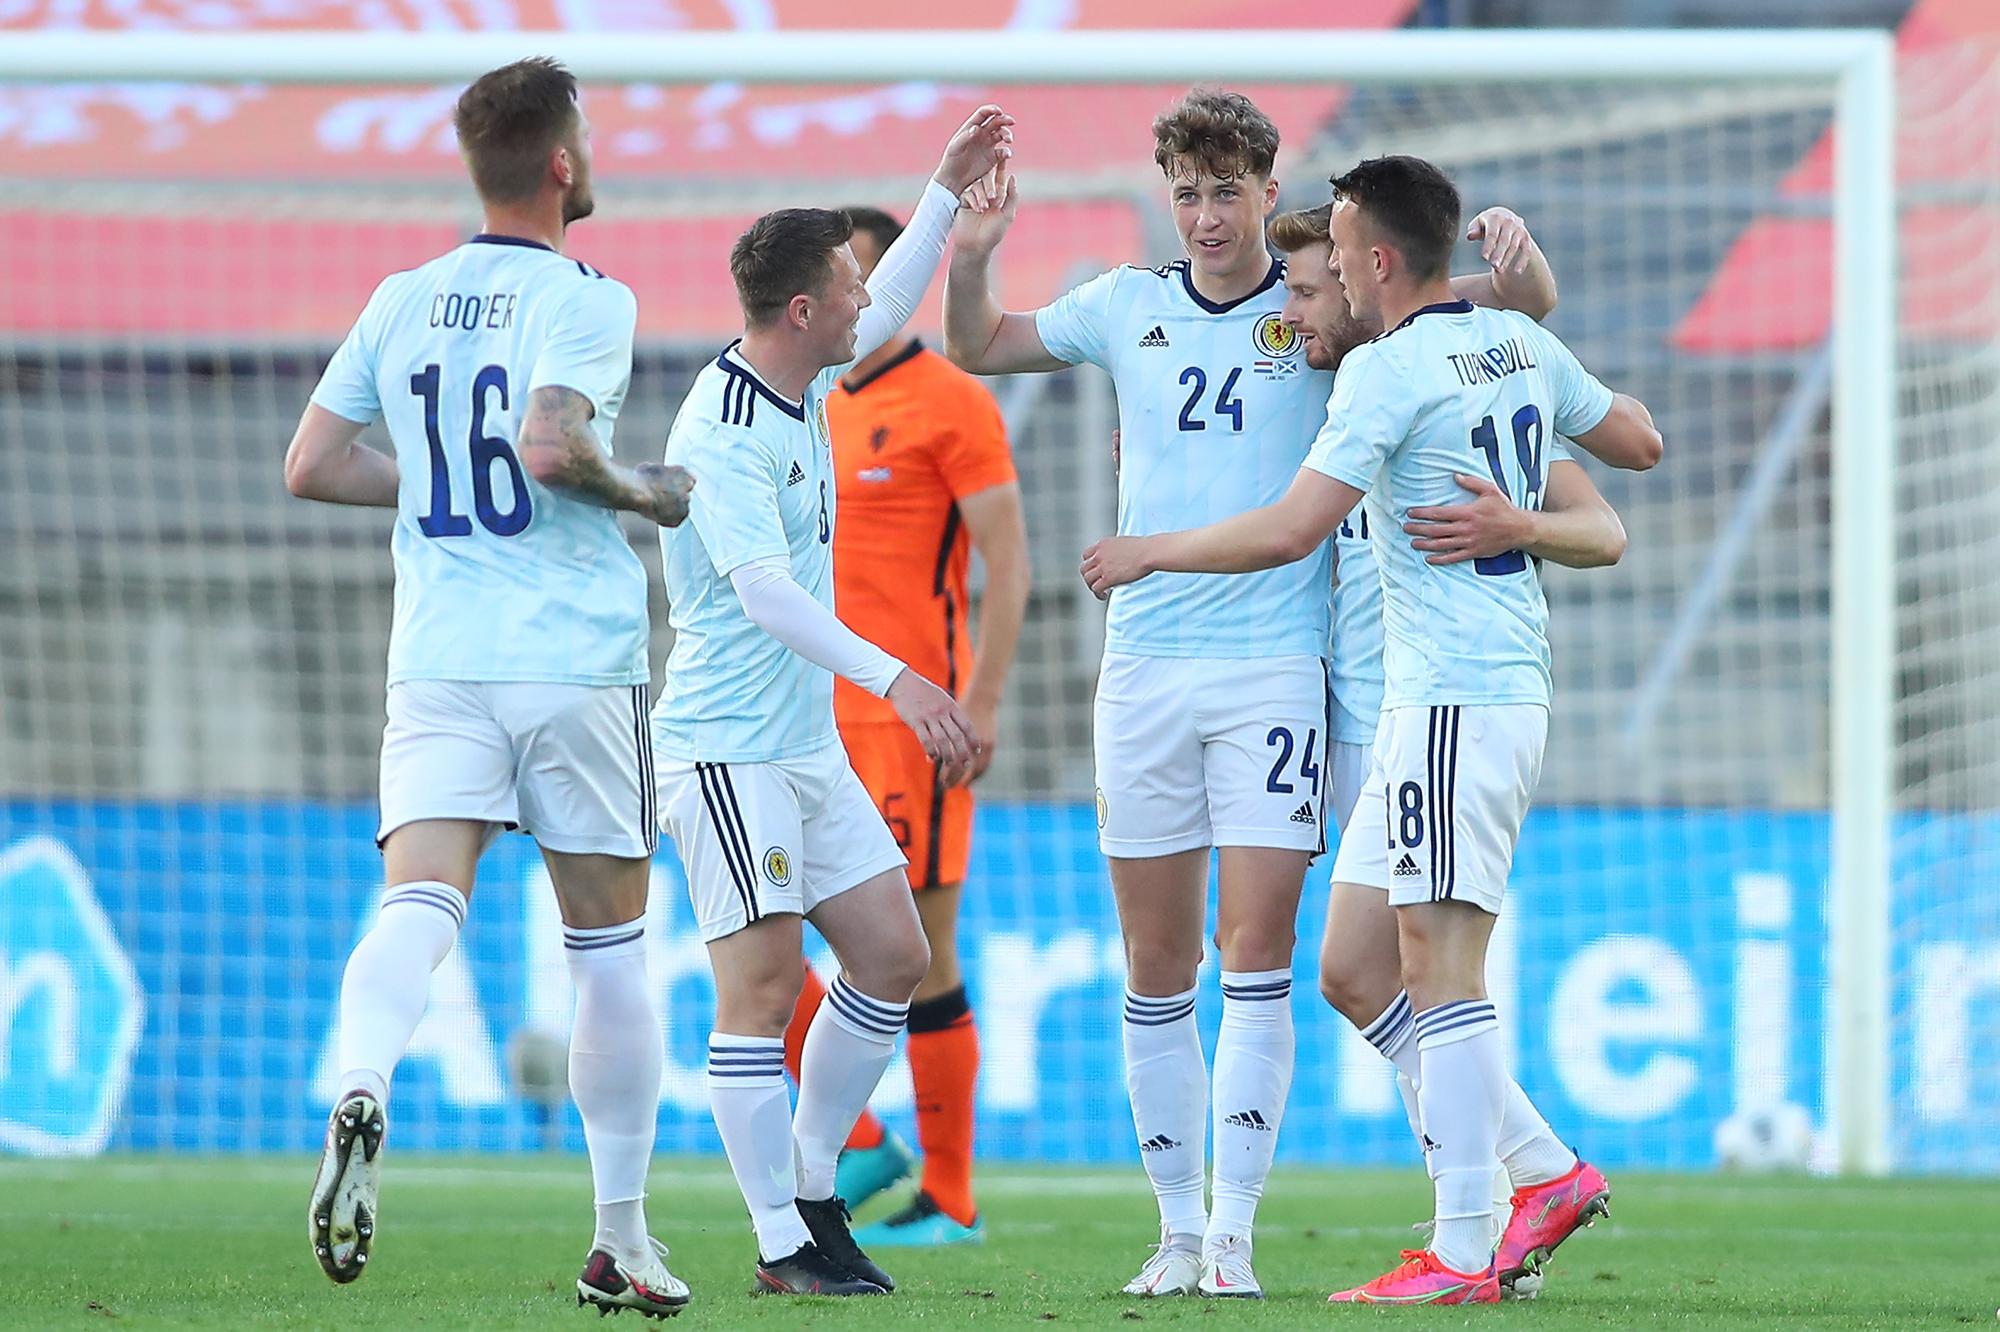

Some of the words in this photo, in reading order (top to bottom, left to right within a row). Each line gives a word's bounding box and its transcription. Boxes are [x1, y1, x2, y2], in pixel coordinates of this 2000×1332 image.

[1138, 339, 1170, 348] adidas
[1447, 335, 1537, 386] TURNBULL
[1178, 366, 1243, 432] 24
[410, 364, 533, 538] 16
[1265, 726, 1320, 797] 24
[1223, 1116, 1272, 1132] adidas
